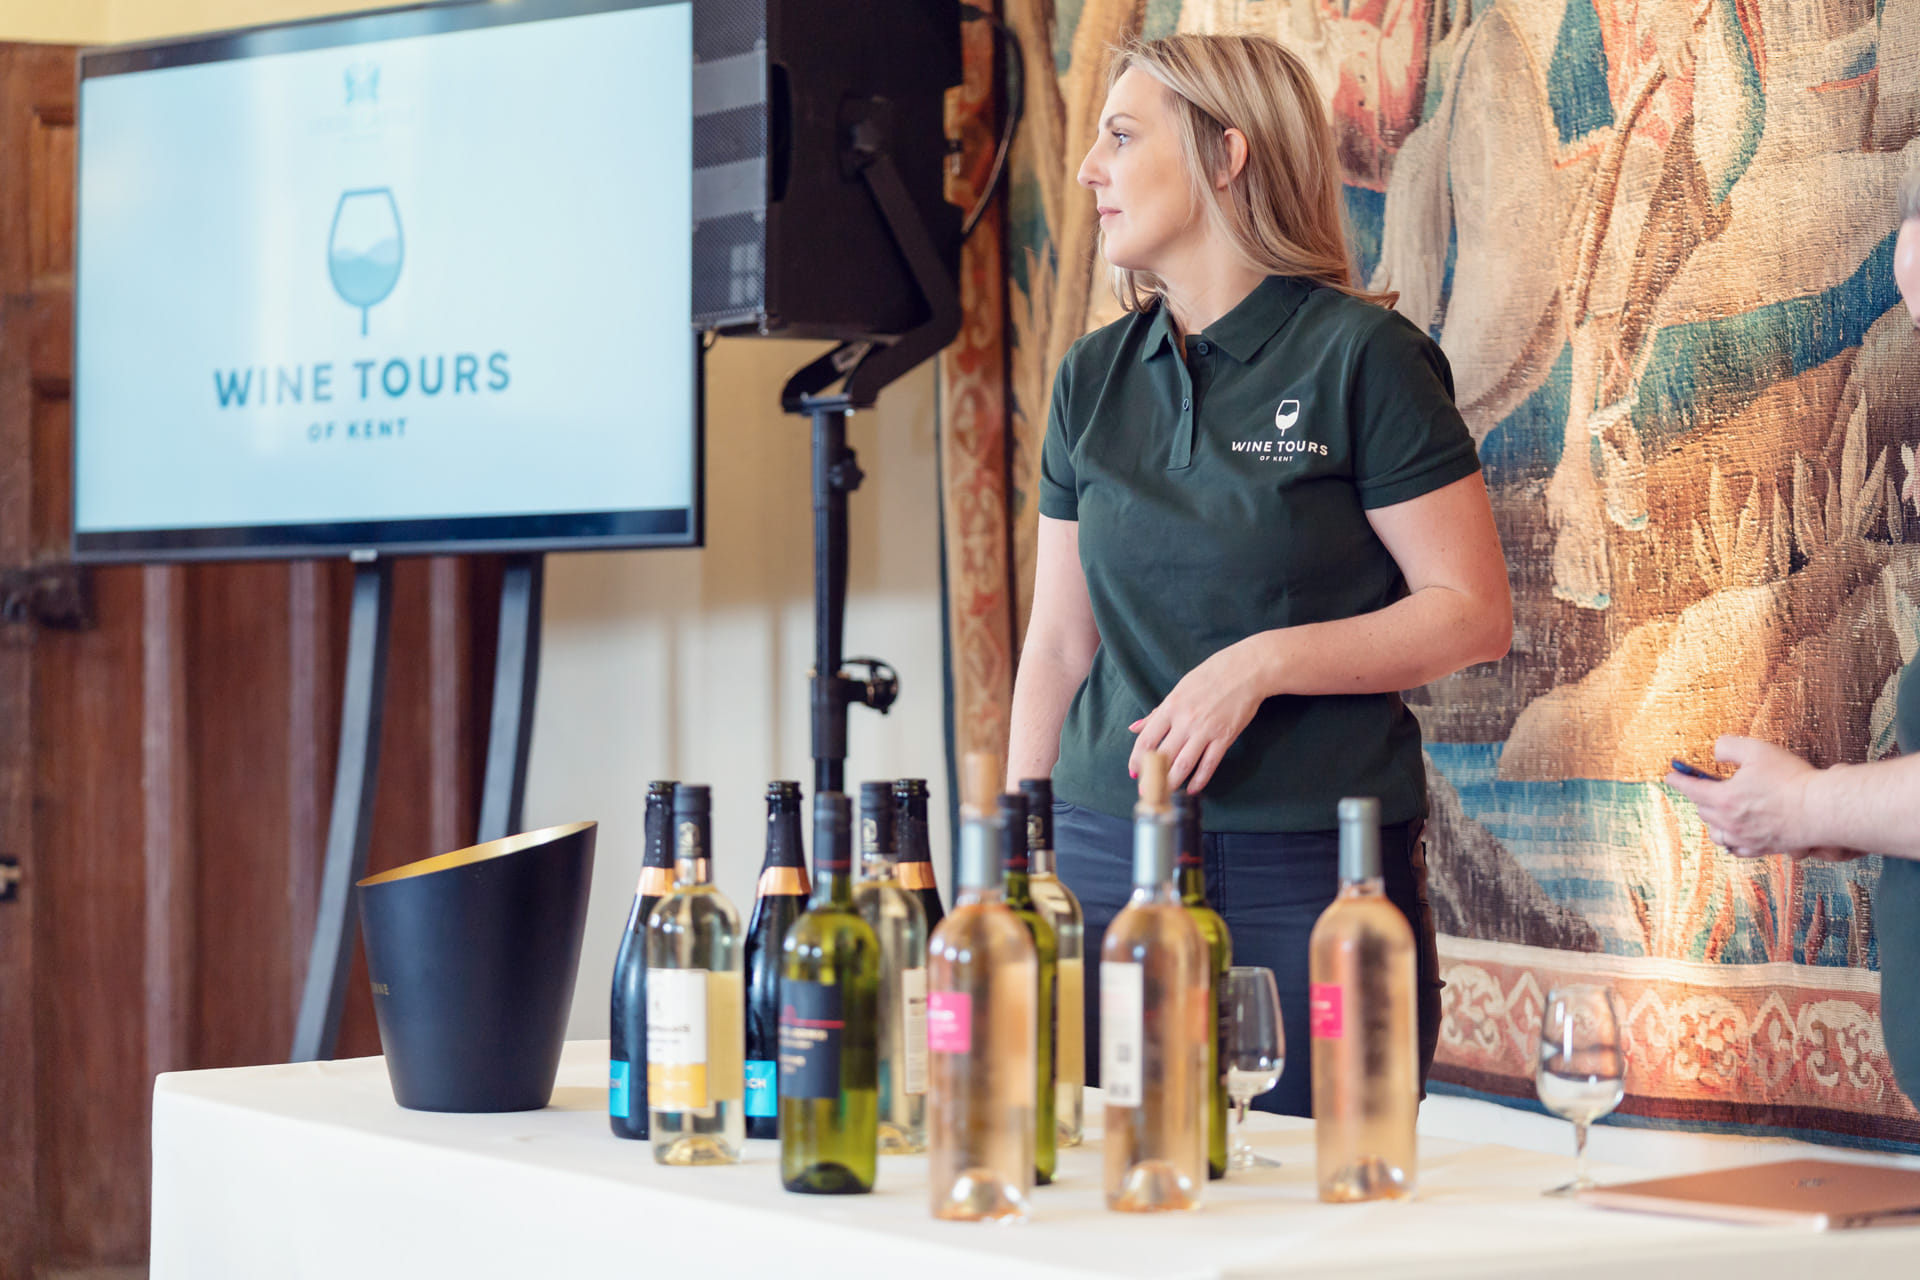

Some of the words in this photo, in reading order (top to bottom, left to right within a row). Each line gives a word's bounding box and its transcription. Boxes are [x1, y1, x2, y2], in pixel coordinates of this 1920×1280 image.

[213, 363, 334, 408] WINE
[352, 350, 511, 400] TOURS
[307, 421, 335, 443] OF
[346, 417, 408, 440] KENT
[1231, 440, 1273, 453] WINE
[1277, 440, 1329, 456] TOURS
